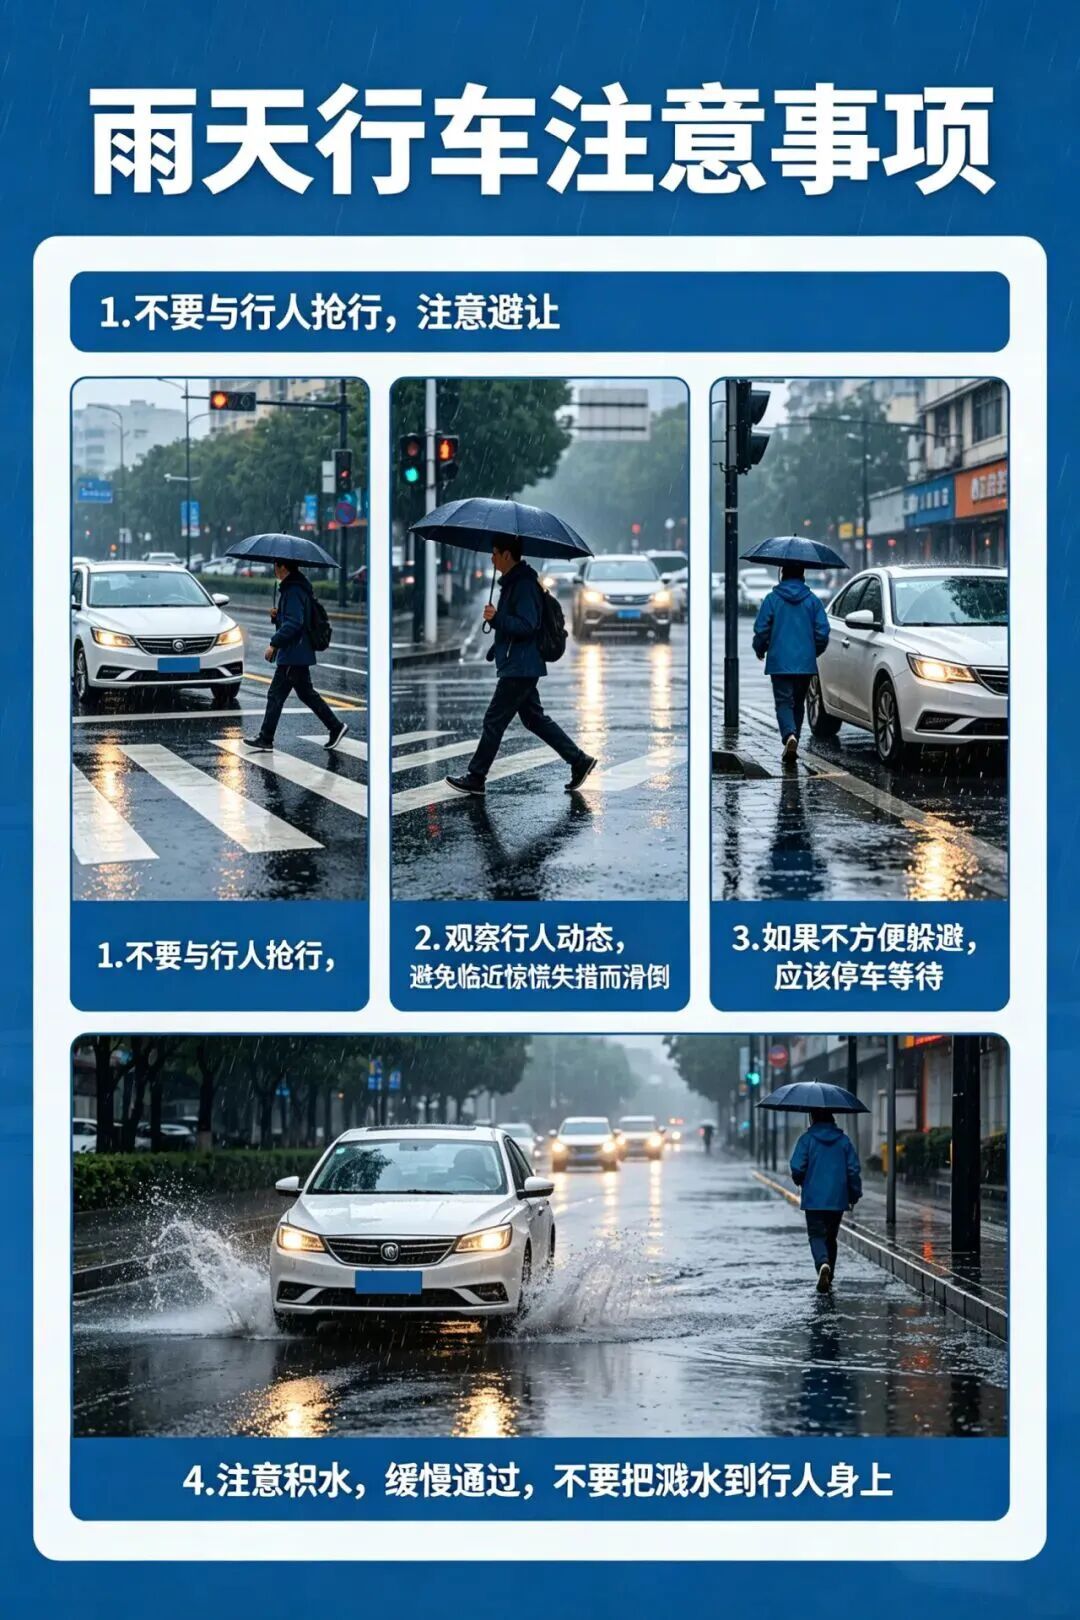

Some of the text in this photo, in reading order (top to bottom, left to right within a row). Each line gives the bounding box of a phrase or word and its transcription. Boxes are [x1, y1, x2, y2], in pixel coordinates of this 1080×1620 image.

[90, 82, 995, 195] 雨天行车注意事项
[101, 292, 560, 332] 1.不要与行人抢行，注意避让
[733, 922, 975, 955] 3.如果不方便躲避，
[98, 939, 335, 973] 1.不要与行人抢行，
[409, 963, 670, 990] 避免临近惊慌失措而滑倒
[775, 961, 944, 991] 应该停车等待
